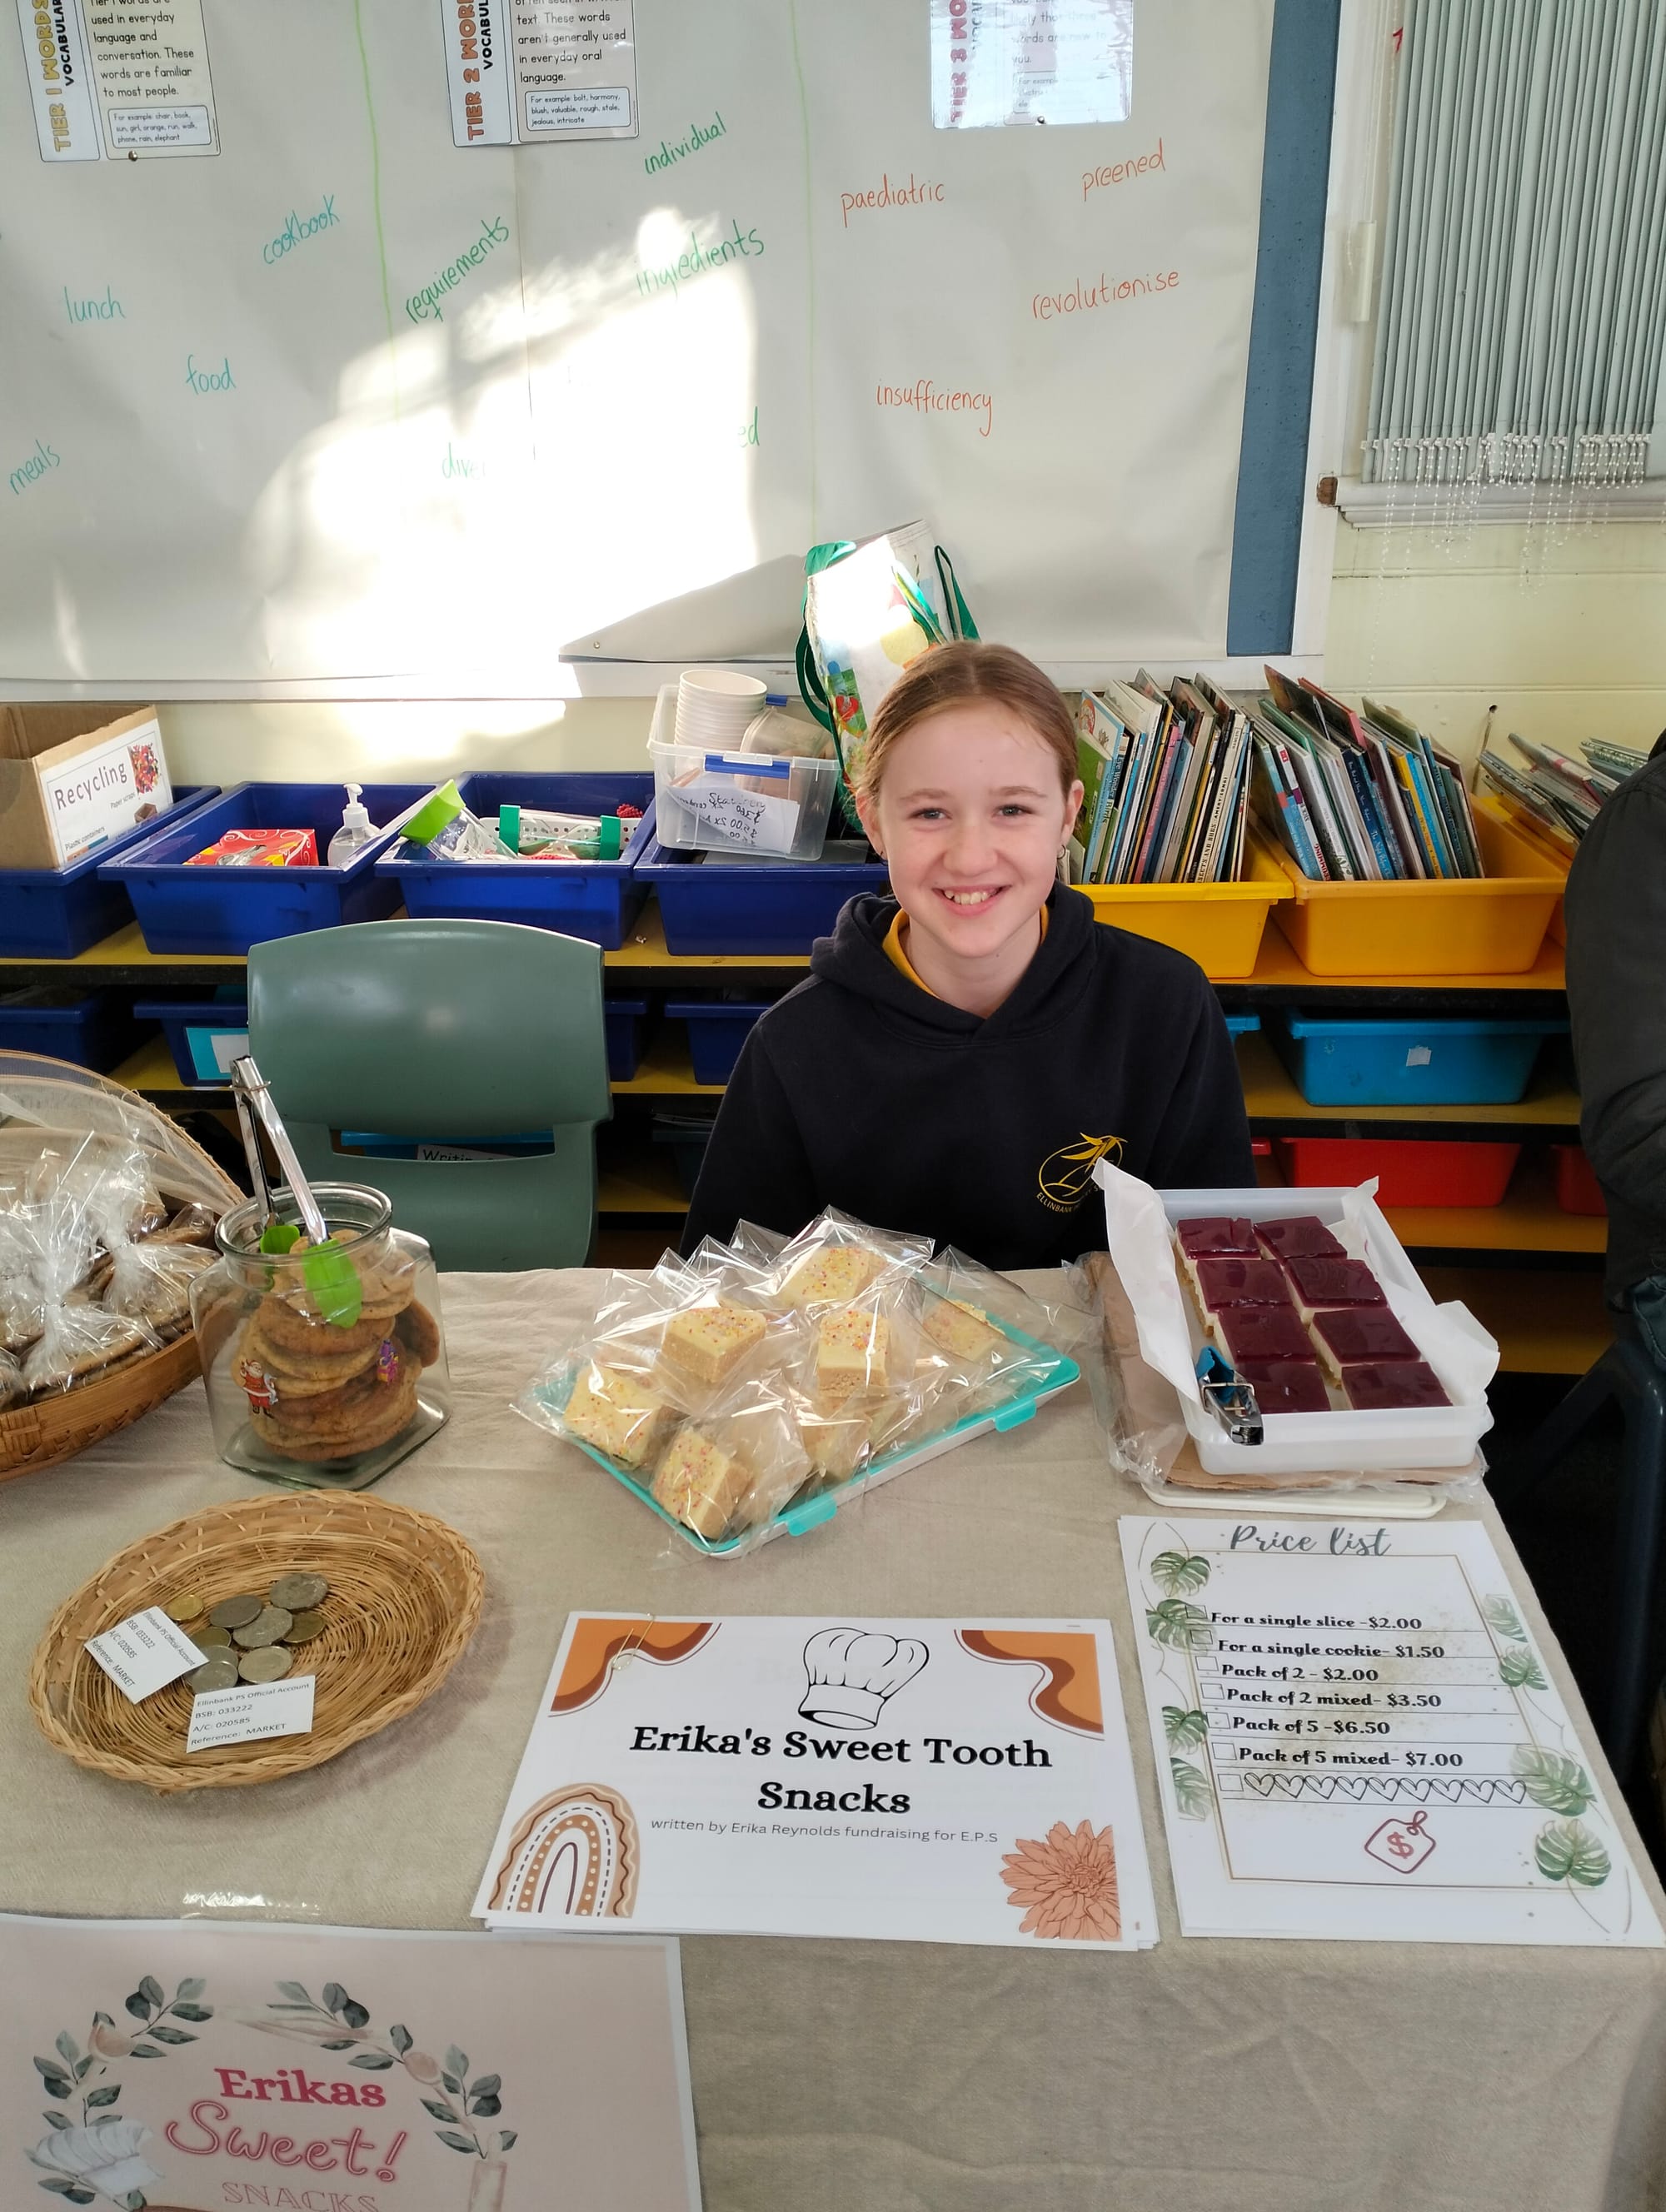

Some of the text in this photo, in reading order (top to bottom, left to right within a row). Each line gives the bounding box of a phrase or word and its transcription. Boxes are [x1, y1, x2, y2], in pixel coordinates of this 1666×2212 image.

[91, 10, 175, 25] used in everyday
[544, 12, 574, 23] These
[578, 9, 611, 22] words
[31, 0, 60, 80] WORDS
[93, 29, 157, 45] language and
[518, 28, 626, 45] aren't generally used
[97, 47, 194, 61] conversation. These
[519, 49, 602, 64] in everyday oral
[100, 65, 192, 79] words are familiar
[456, 0, 484, 141] TIER 2 WOR
[520, 72, 566, 85] language.
[103, 84, 179, 98] to most people.
[590, 93, 620, 102] harmony,
[49, 102, 72, 152] TIER
[113, 112, 125, 121] For
[531, 118, 555, 127] jealous,
[154, 134, 180, 144] elephant
[644, 111, 727, 176] individual
[1082, 137, 1166, 202] preened
[840, 172, 945, 228] paediatric
[262, 194, 340, 264] cookbook
[405, 216, 510, 324] requirements
[636, 219, 764, 301] ingredients
[63, 285, 127, 324] lunch
[1032, 271, 1180, 321] revolutionise
[186, 354, 236, 396] food
[876, 378, 992, 437] insufficiency
[9, 439, 61, 495] meals
[54, 762, 127, 810] Recycling
[1102, 756, 1124, 824] Eye Wonder Birds
[65, 839, 81, 851] Plastic
[1230, 1525, 1392, 1557] Price list
[1211, 1612, 1240, 1624] For
[1244, 1616, 1255, 1624] a
[1259, 1614, 1312, 1629] single
[1316, 1616, 1355, 1628] slice
[108, 1631, 137, 1658] A/C: 020585
[127, 1620, 156, 1649] BSB: 033222
[1219, 1640, 1247, 1652] For
[1251, 1644, 1263, 1653] a
[1267, 1642, 1320, 1657] single
[1395, 1645, 1445, 1658] $1.50
[91, 1640, 136, 1686] Reference: MARKET
[1222, 1664, 1267, 1678] Pack
[1271, 1666, 1289, 1680] of
[1292, 1668, 1305, 1679] 2
[1323, 1668, 1379, 1681] $2.00
[197, 1696, 233, 1706] Ellinbank
[247, 1689, 276, 1699] Official
[277, 1683, 310, 1693] Account
[1227, 1688, 1274, 1702] Pack
[1278, 1691, 1295, 1705] of
[1299, 1691, 1312, 1704] 2
[1387, 1693, 1442, 1707] $3.50
[195, 1705, 253, 1719] BSB: 033222
[191, 1723, 287, 1746] Reference: MARKET
[192, 1717, 251, 1733] A/C: 020585
[1233, 1716, 1280, 1731] Pack
[1284, 1719, 1303, 1734] of
[1307, 1720, 1319, 1733] 5
[630, 1726, 1053, 1768] Erika's Sweet Tooth
[1239, 1747, 1289, 1761] Pack
[1292, 1750, 1310, 1765] of
[1314, 1751, 1327, 1763] 5
[1405, 1752, 1463, 1766] $7.00
[756, 1781, 911, 1814] Snacks
[651, 1819, 998, 1843] written by Erika Reynolds fundraising for E.P.S
[214, 2067, 387, 2107] Erikas
[165, 2100, 407, 2182] Sweet!
[222, 2180, 380, 2212] SNACKS
